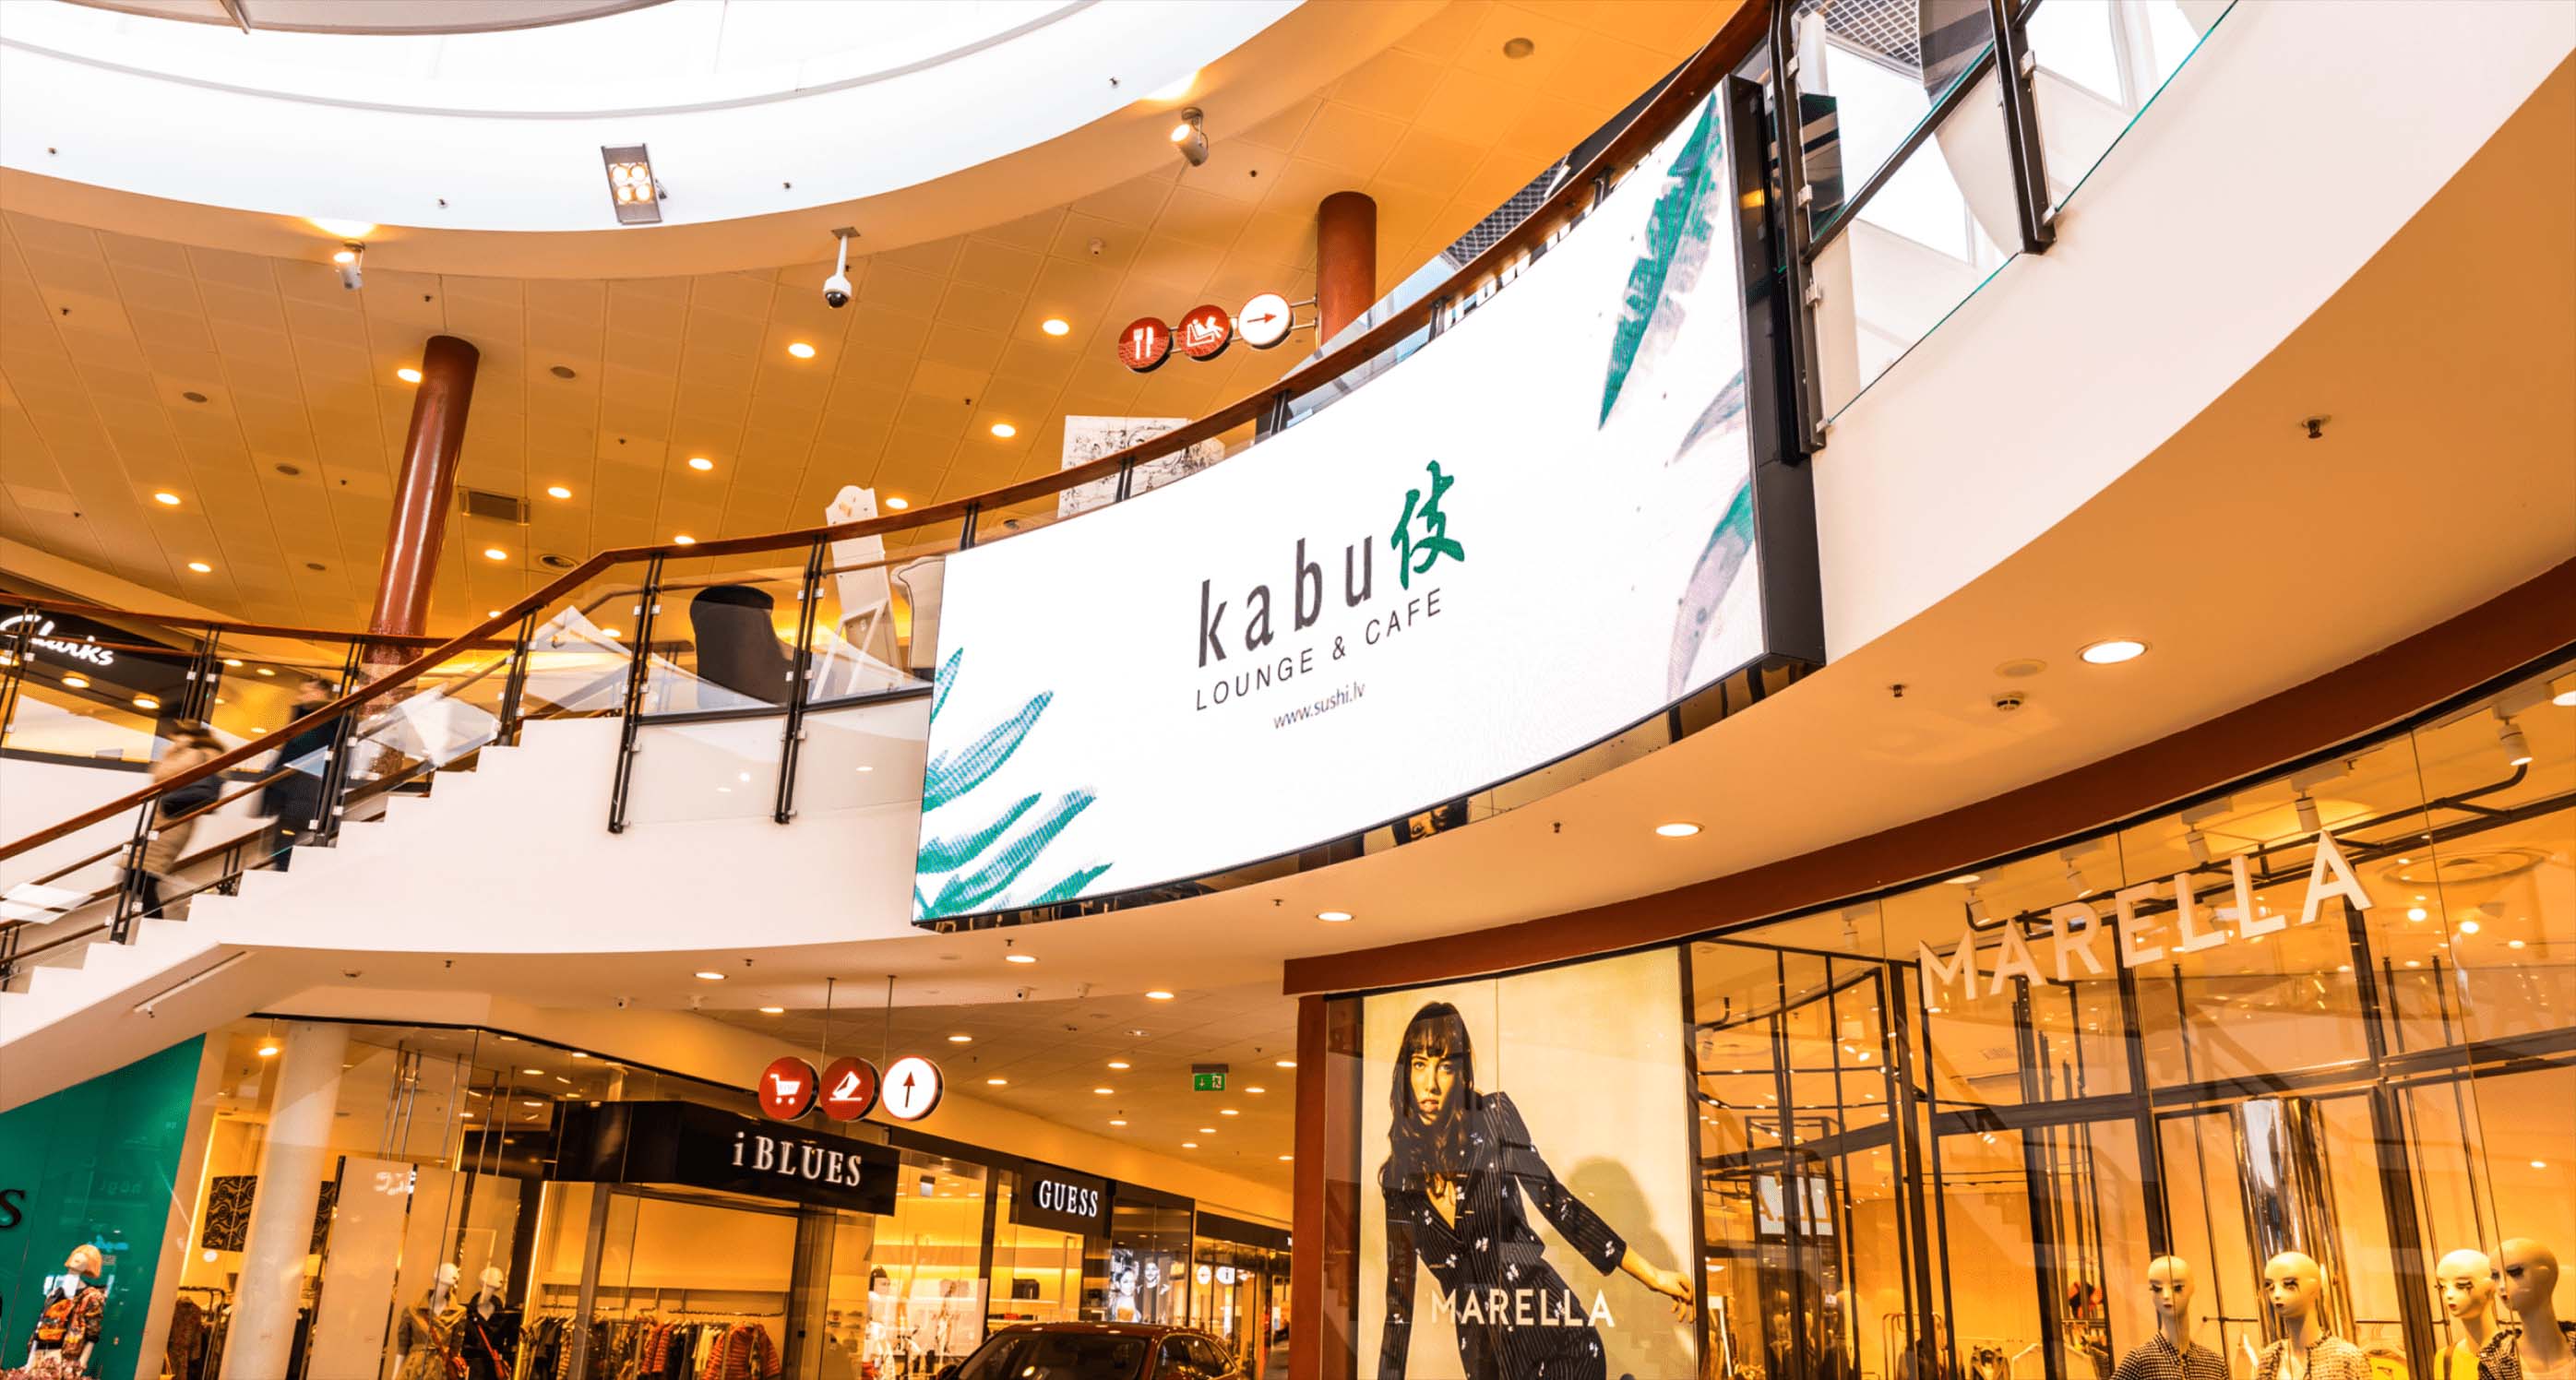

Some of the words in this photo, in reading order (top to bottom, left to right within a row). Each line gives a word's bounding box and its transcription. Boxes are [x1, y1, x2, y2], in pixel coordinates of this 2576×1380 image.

[1196, 648, 1314, 712] LOUNGE
[1331, 635, 1347, 661] &
[1365, 587, 1442, 646] CAFE
[1272, 681, 1366, 730] www.sushi.lv
[1917, 829, 2374, 1009] MARELLA
[1038, 1179, 1099, 1219] GUESS
[1430, 1288, 1616, 1327] MARELLA
